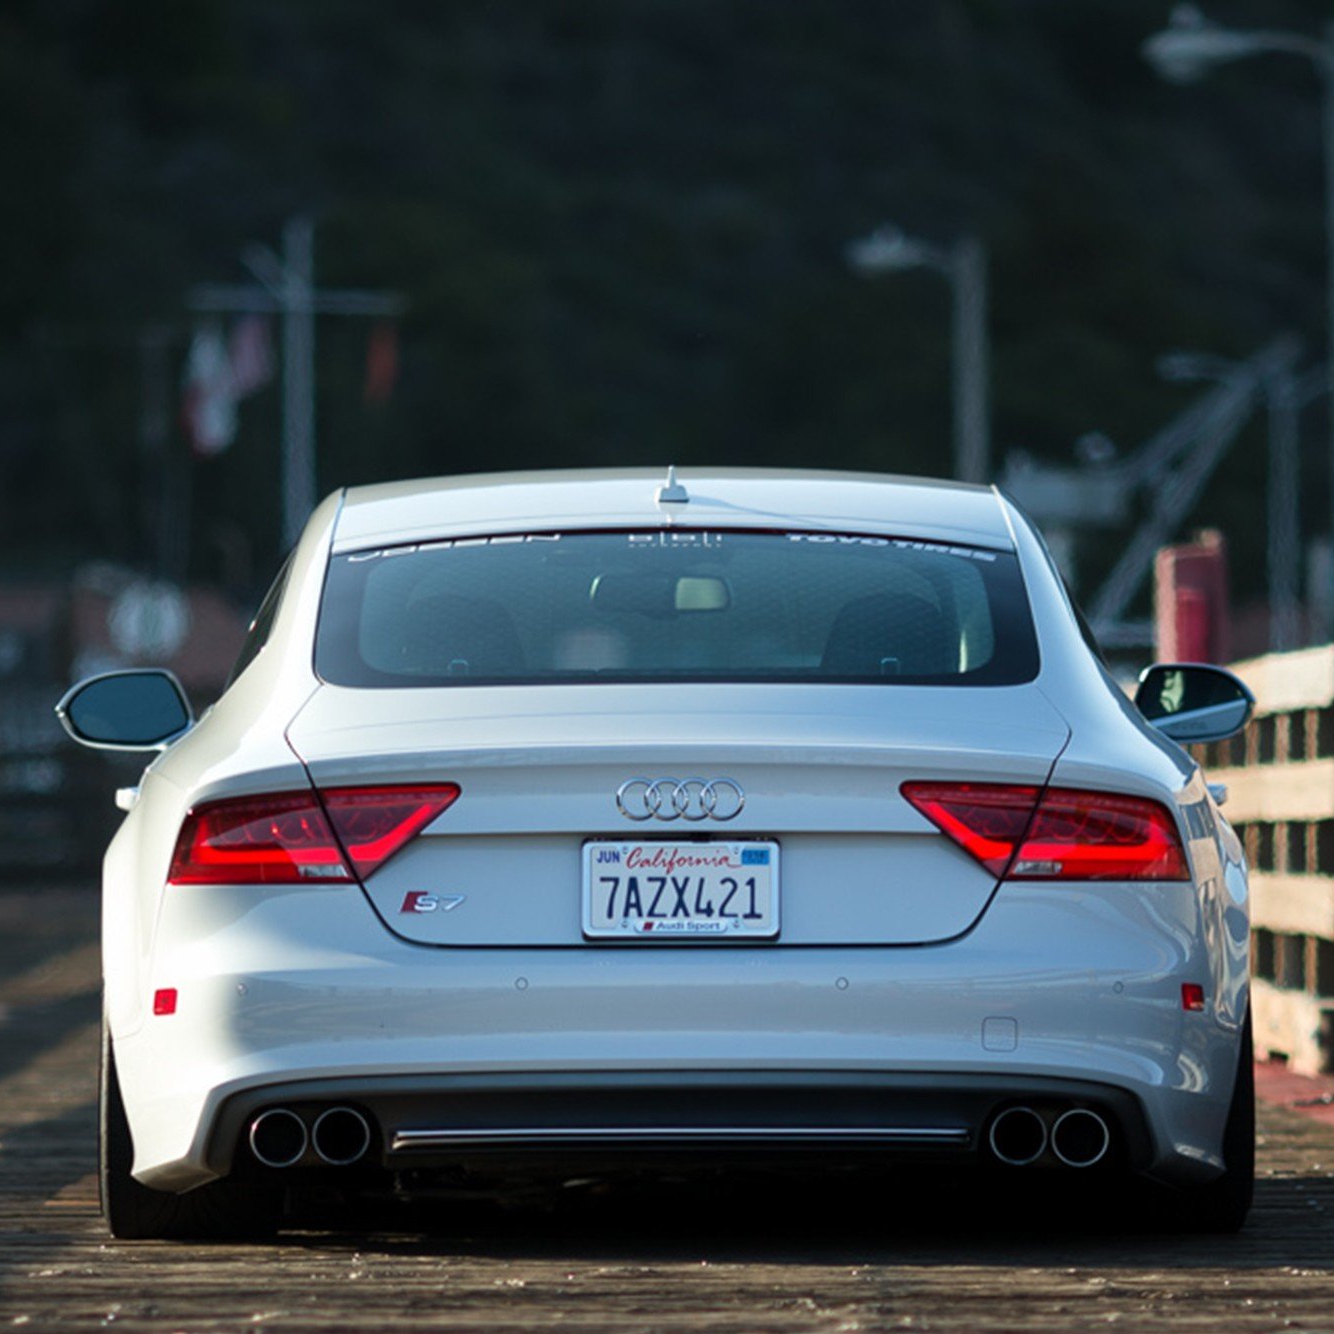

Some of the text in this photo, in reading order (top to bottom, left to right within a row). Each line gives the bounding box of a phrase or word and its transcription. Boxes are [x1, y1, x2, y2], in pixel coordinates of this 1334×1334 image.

[596, 850, 620, 863] JUN
[626, 846, 742, 875] California
[413, 894, 466, 912] S7
[599, 876, 763, 919] 7AZX421
[656, 921, 720, 932] Audi Sport
